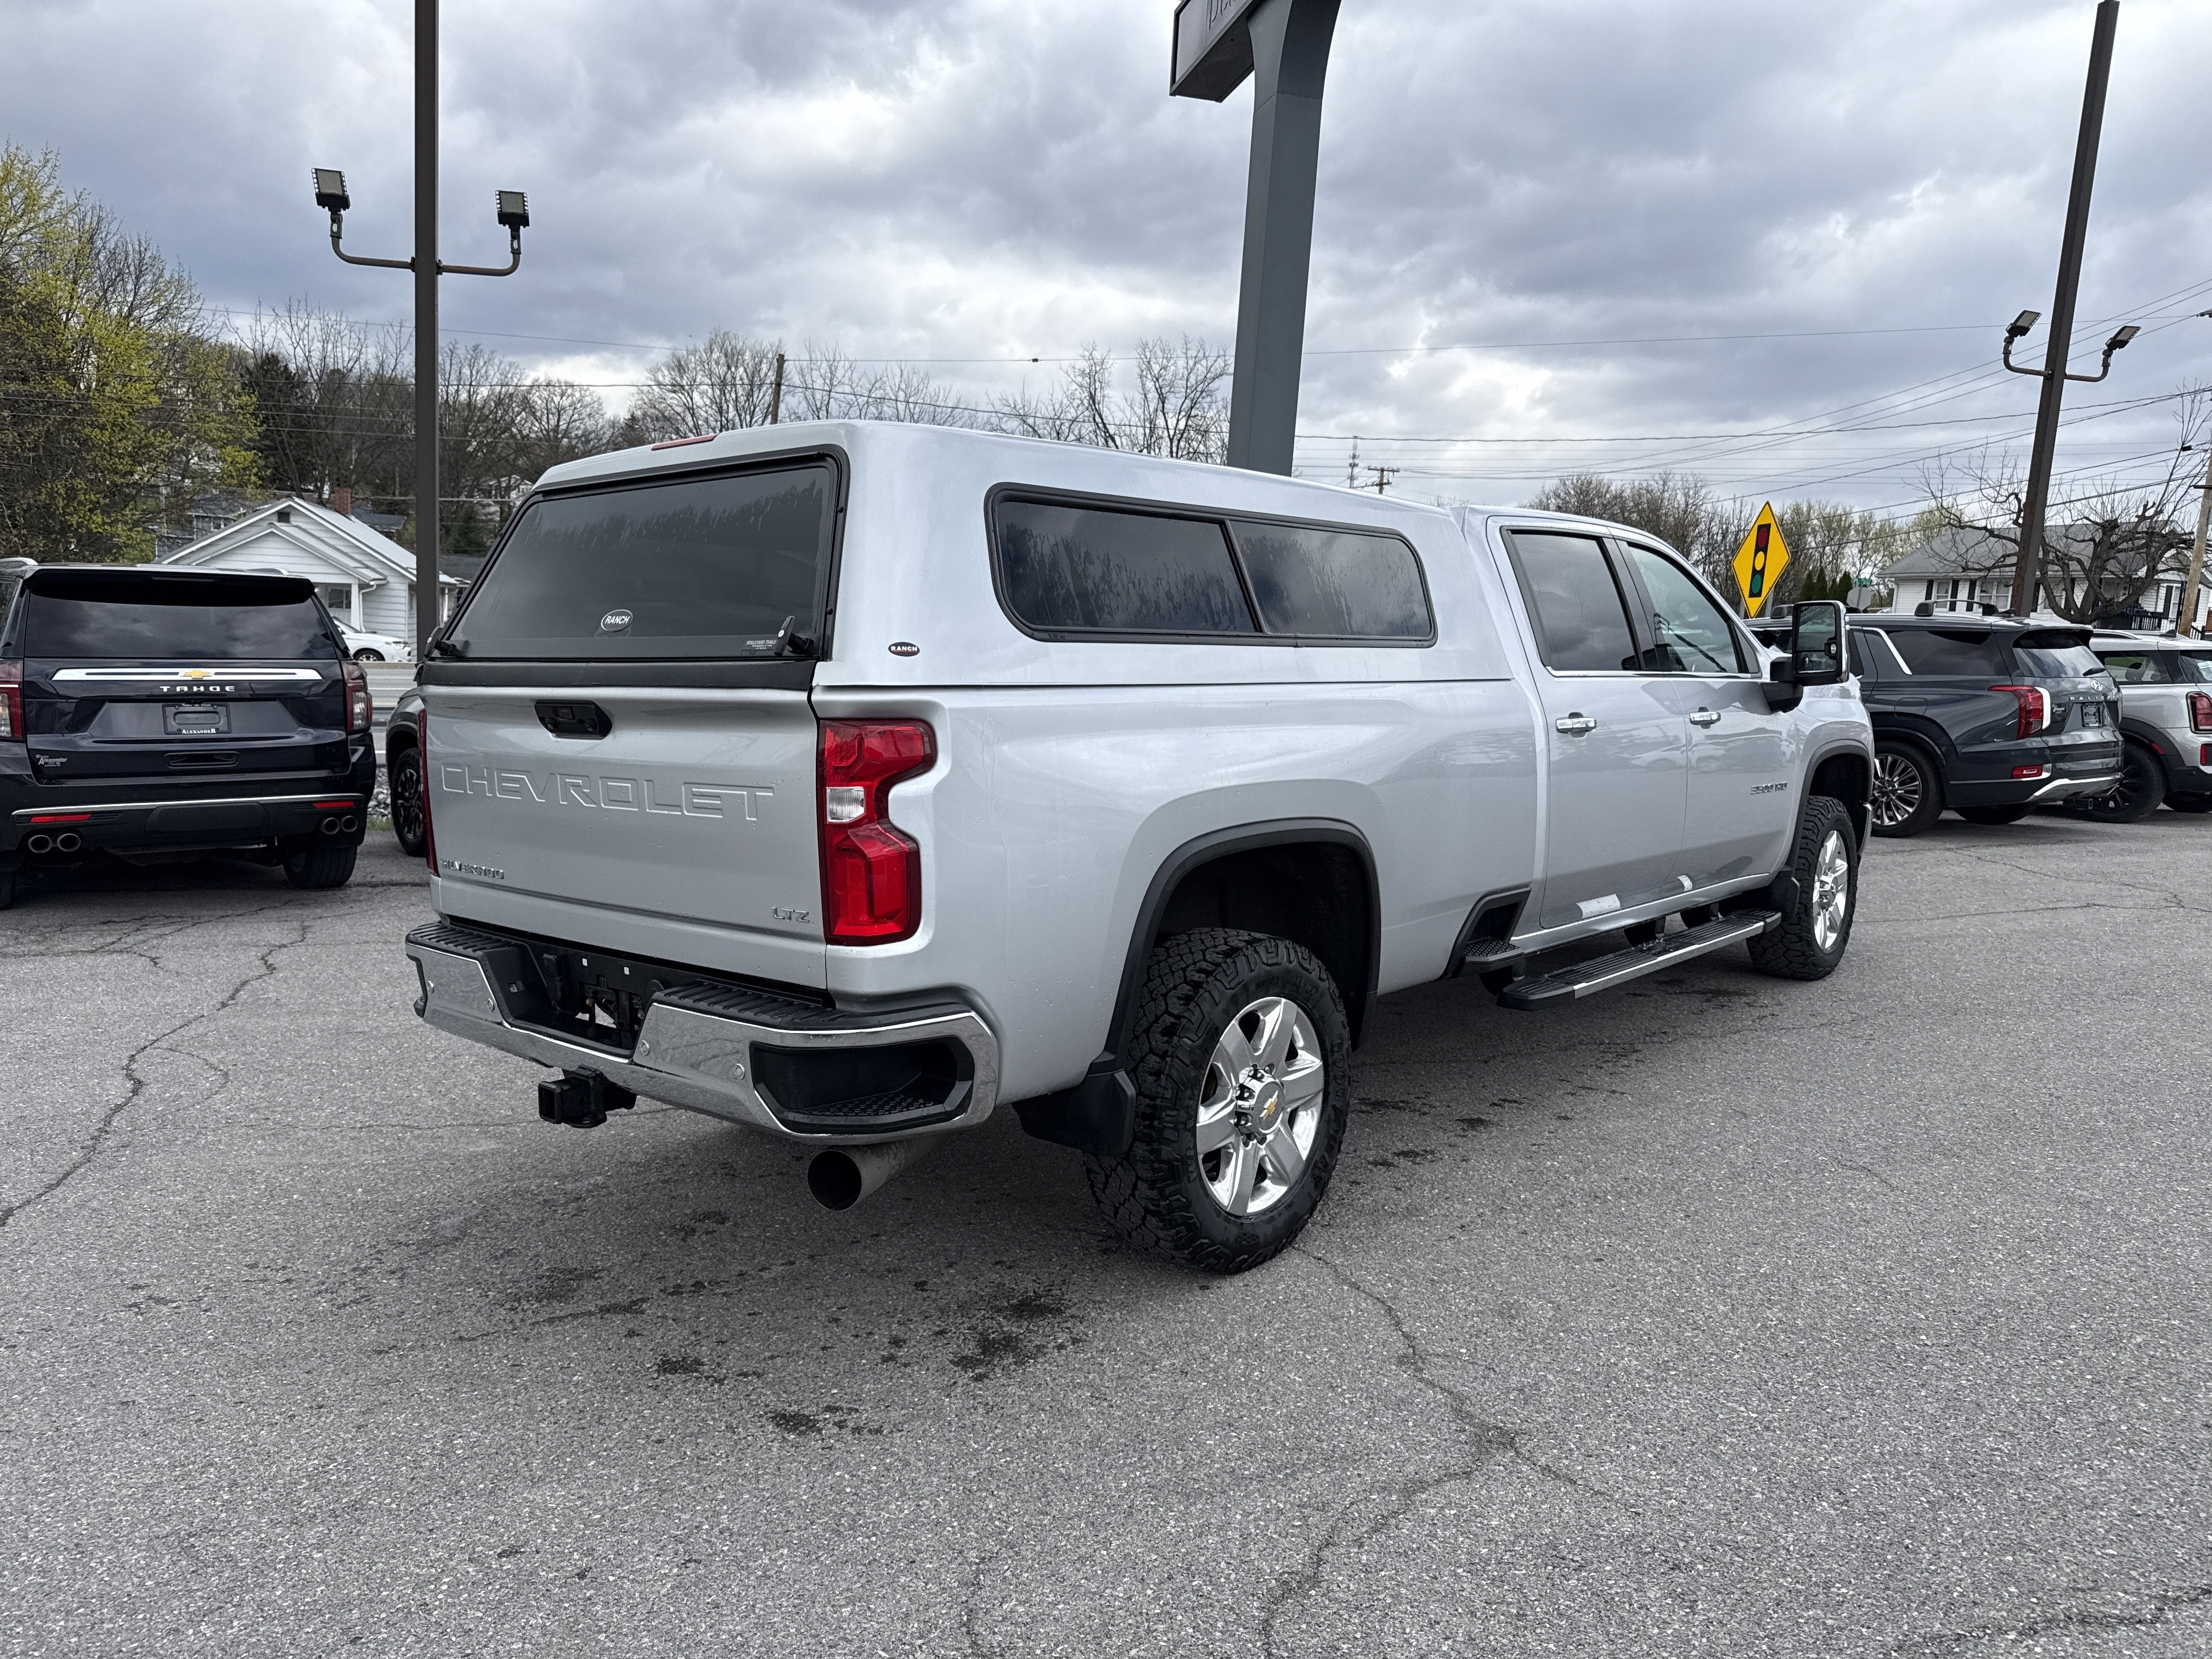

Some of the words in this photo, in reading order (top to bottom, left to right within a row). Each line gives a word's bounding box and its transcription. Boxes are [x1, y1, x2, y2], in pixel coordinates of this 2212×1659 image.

[604, 616, 630, 624] RANCH
[38, 757, 68, 765] Alexander
[441, 763, 775, 821] CHEVROLET
[1775, 781, 1787, 792] HD
[440, 858, 505, 879] SILVERADO
[771, 907, 810, 923] LTZ
